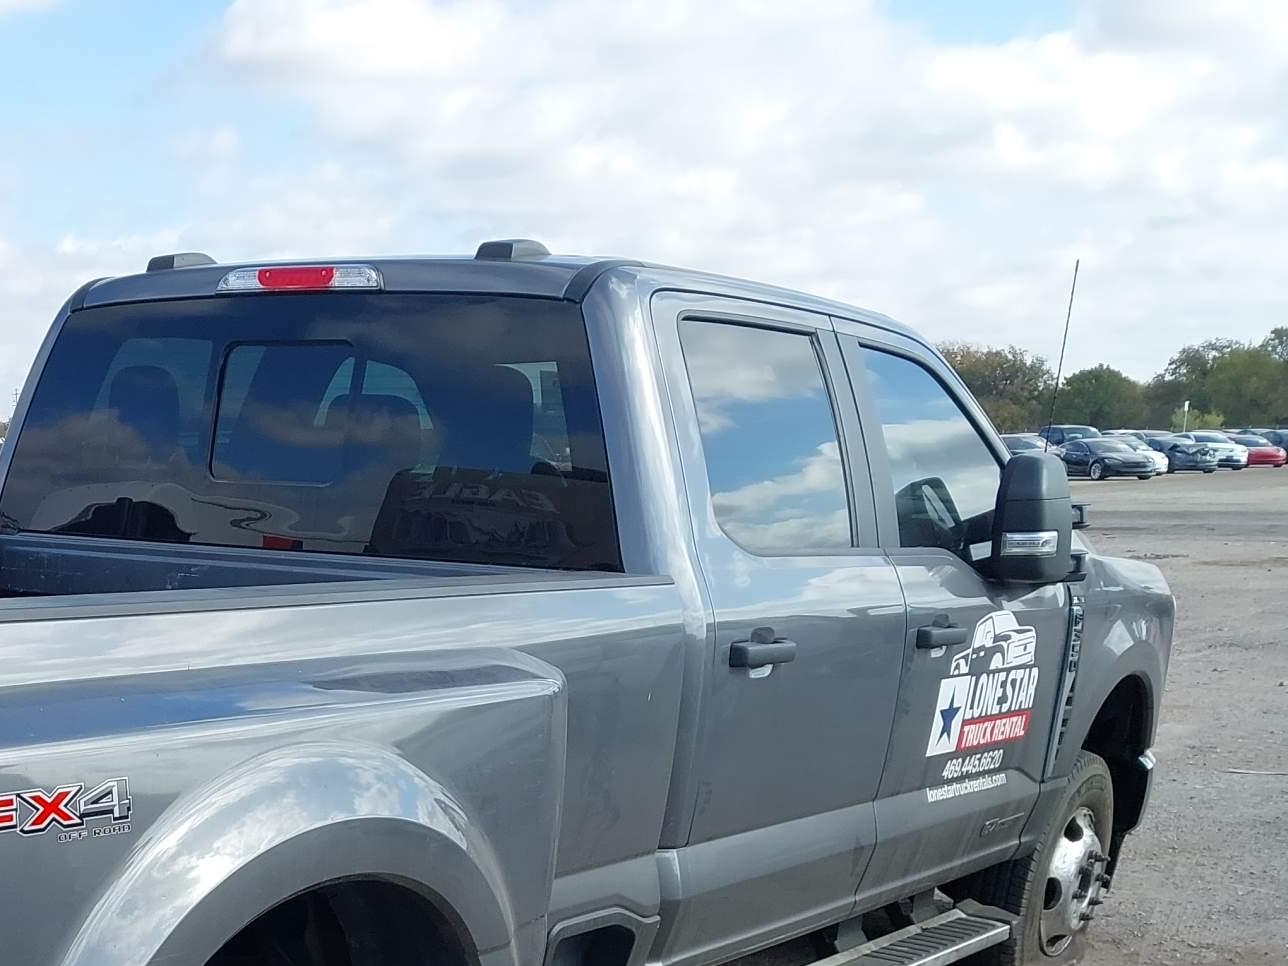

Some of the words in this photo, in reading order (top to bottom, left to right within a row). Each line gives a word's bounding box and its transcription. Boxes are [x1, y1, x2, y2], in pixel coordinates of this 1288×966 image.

[964, 671, 1007, 719] LONE
[1001, 667, 1039, 712] STAR
[961, 720, 995, 748] TRUCK
[992, 715, 1026, 741] RENTAL
[942, 749, 1004, 779] 469.445.6620
[926, 773, 1007, 802] lonestartruckrentals.com
[58, 831, 88, 843] OFF
[93, 824, 132, 838] ROAD
